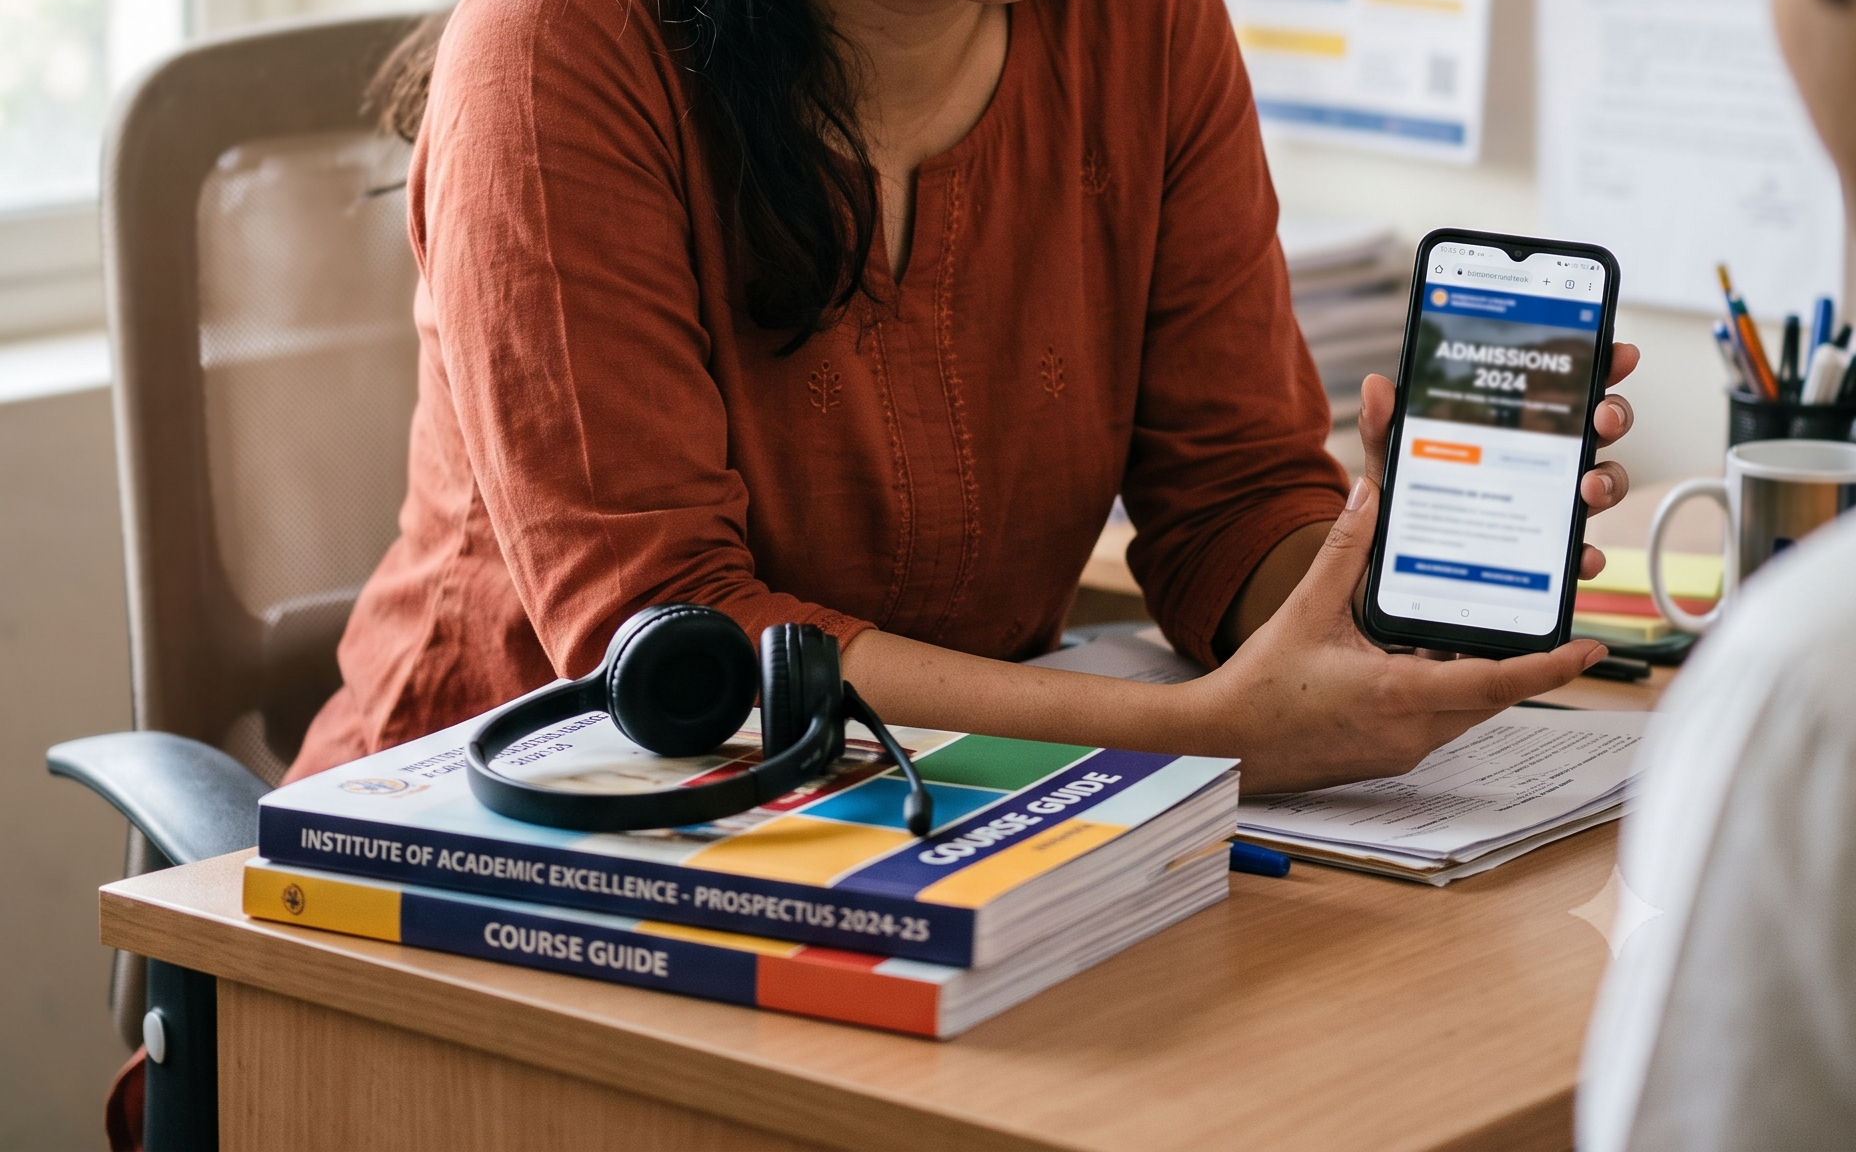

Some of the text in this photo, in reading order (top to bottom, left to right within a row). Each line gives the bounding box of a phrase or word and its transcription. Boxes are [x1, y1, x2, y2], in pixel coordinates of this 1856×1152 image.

[1435, 340, 1573, 374] ADMISSIONS
[1473, 368, 1528, 391] 2024
[918, 812, 1043, 865] COURSE
[1026, 771, 1123, 814] GUIDE
[301, 828, 402, 862] INSTITUTE
[406, 844, 434, 866] OF
[437, 850, 546, 884] ACADEMIC
[549, 864, 679, 904] EXCELLENCE
[694, 886, 836, 928] PROSPECTUS
[838, 907, 931, 942] 2024-25
[484, 921, 669, 978] COURSE GUIDE
